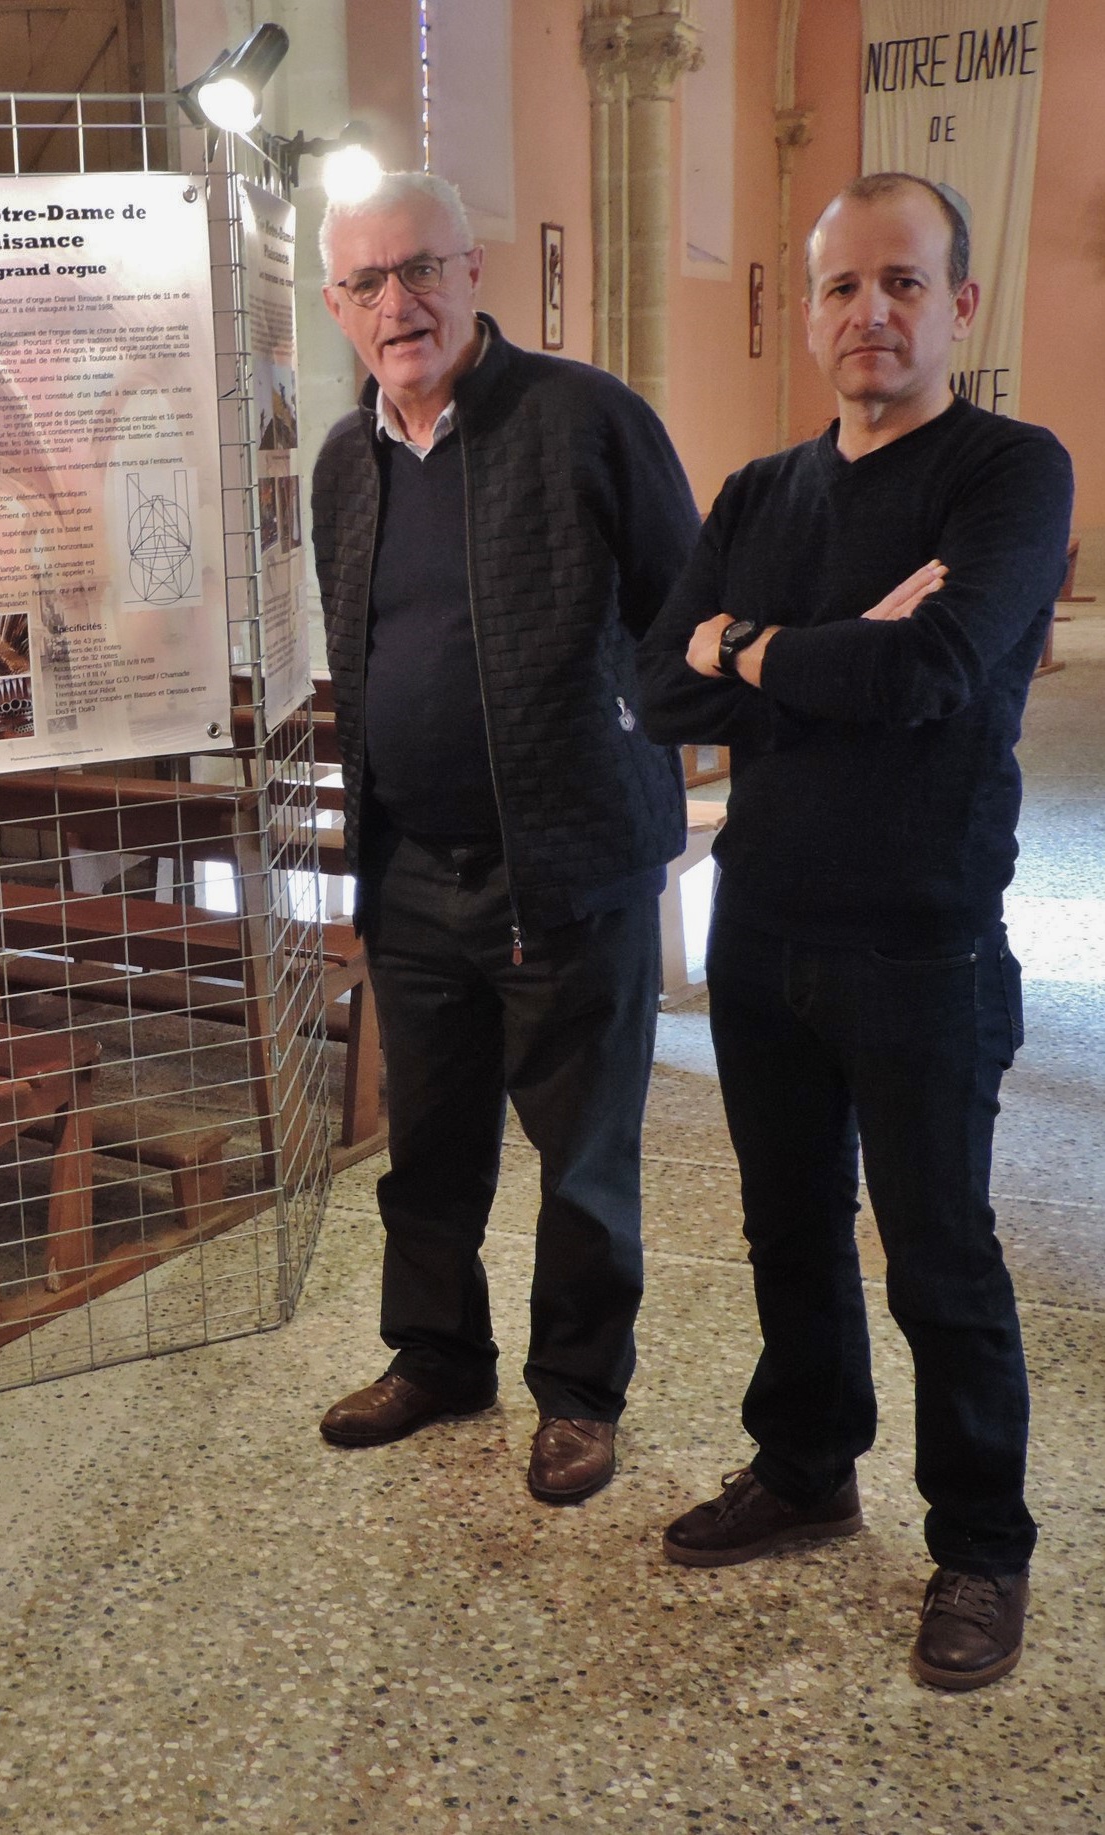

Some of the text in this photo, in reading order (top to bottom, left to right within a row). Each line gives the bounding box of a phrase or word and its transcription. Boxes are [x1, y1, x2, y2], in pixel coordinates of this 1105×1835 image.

[865, 21, 1038, 94] NOTRE DAME
[930, 115, 957, 143] DE
[122, 204, 146, 219] de
[57, 266, 106, 278] orgue
[949, 369, 1009, 415] NCE
